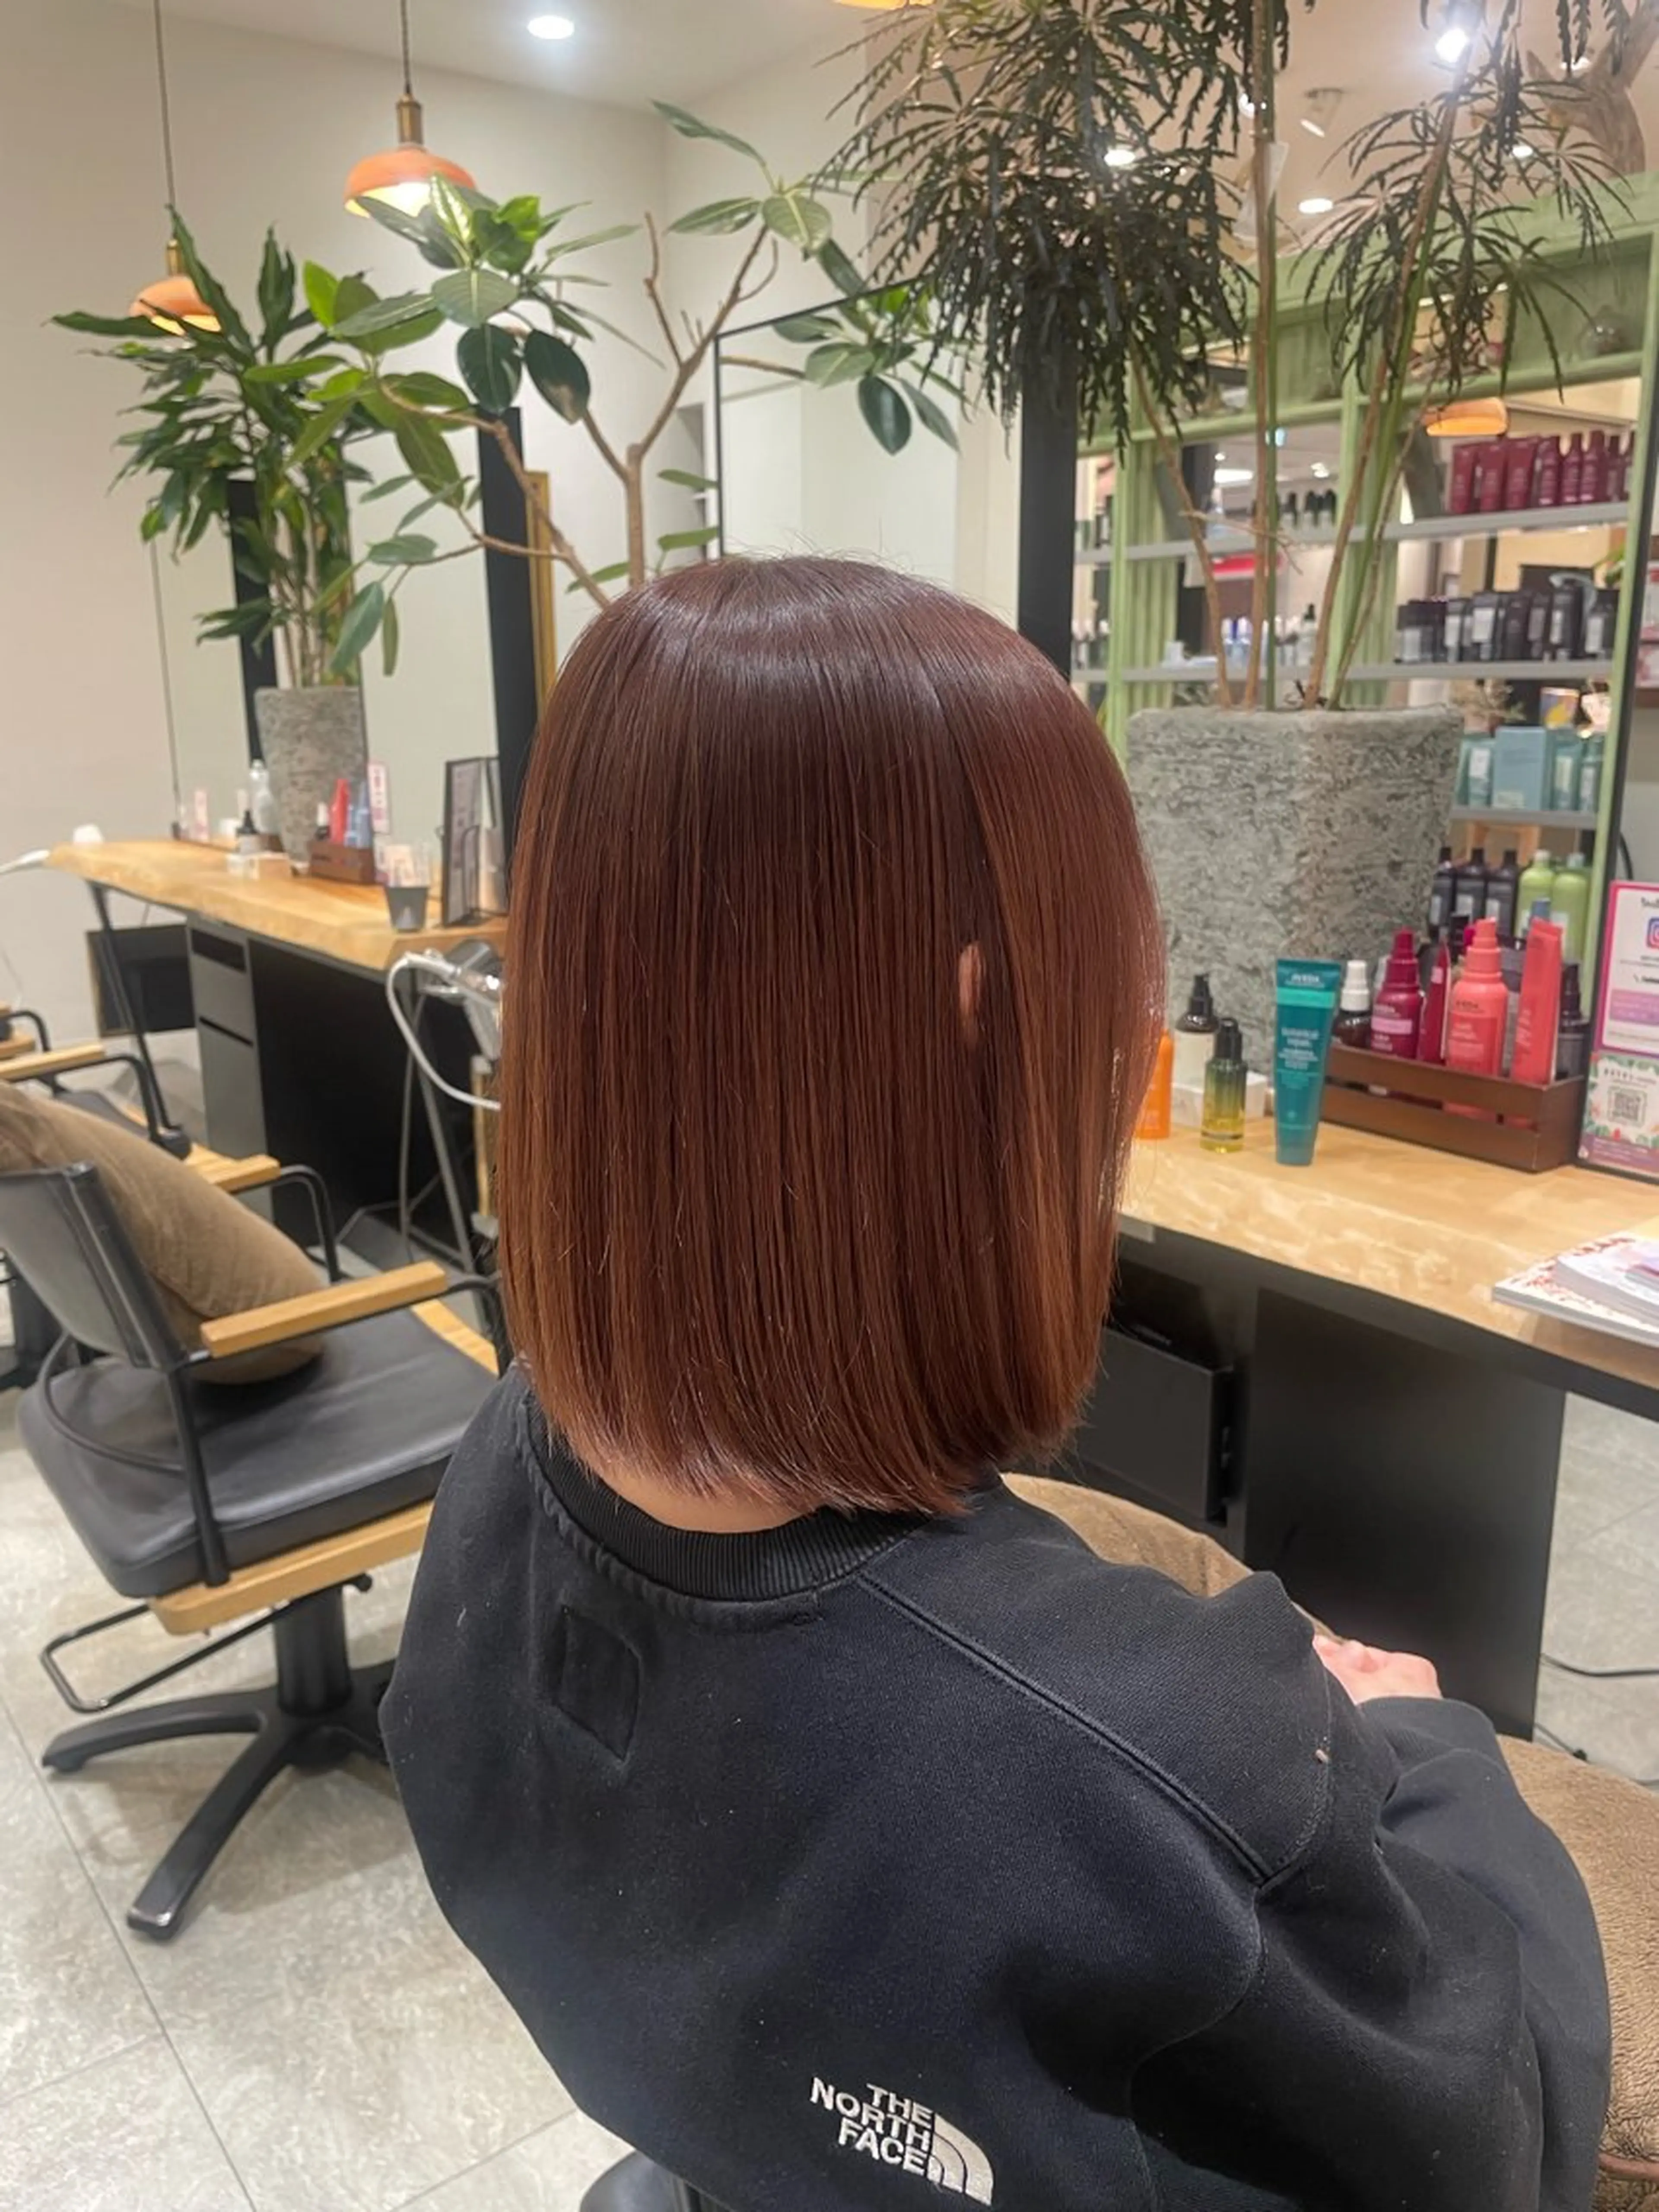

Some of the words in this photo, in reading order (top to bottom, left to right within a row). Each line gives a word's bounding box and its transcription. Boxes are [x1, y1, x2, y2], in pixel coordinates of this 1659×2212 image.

[810, 2076, 930, 2151] NORTH
[866, 2082, 934, 2129] THE
[838, 2117, 927, 2176] FACE
